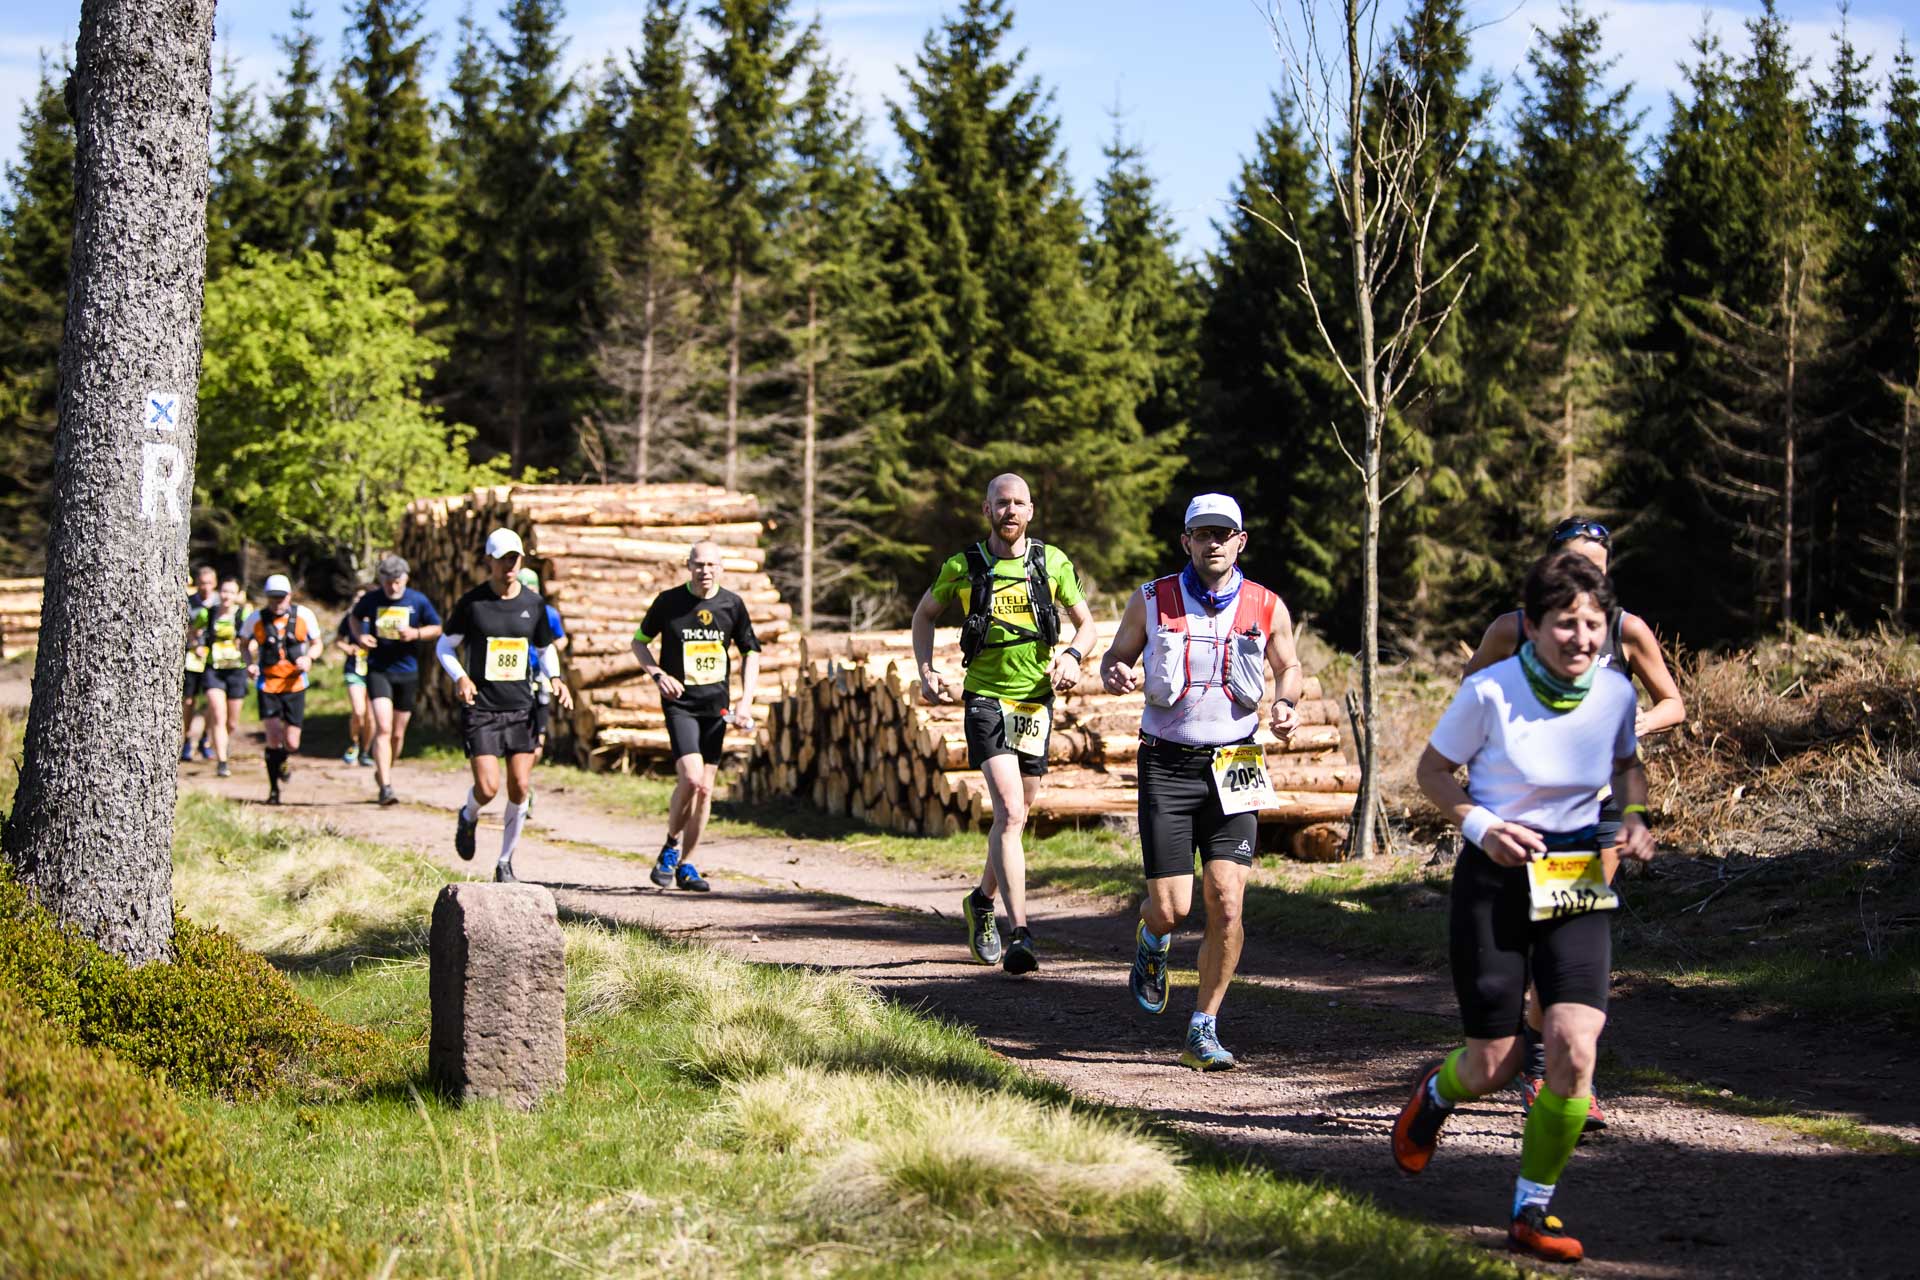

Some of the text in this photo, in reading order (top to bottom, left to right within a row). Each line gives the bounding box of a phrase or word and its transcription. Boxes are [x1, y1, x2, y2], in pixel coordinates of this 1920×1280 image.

[141, 442, 184, 521] R
[498, 653, 518, 667] 888
[695, 657, 716, 671] 843
[1013, 715, 1040, 737] 1385
[1227, 767, 1266, 792] 2054
